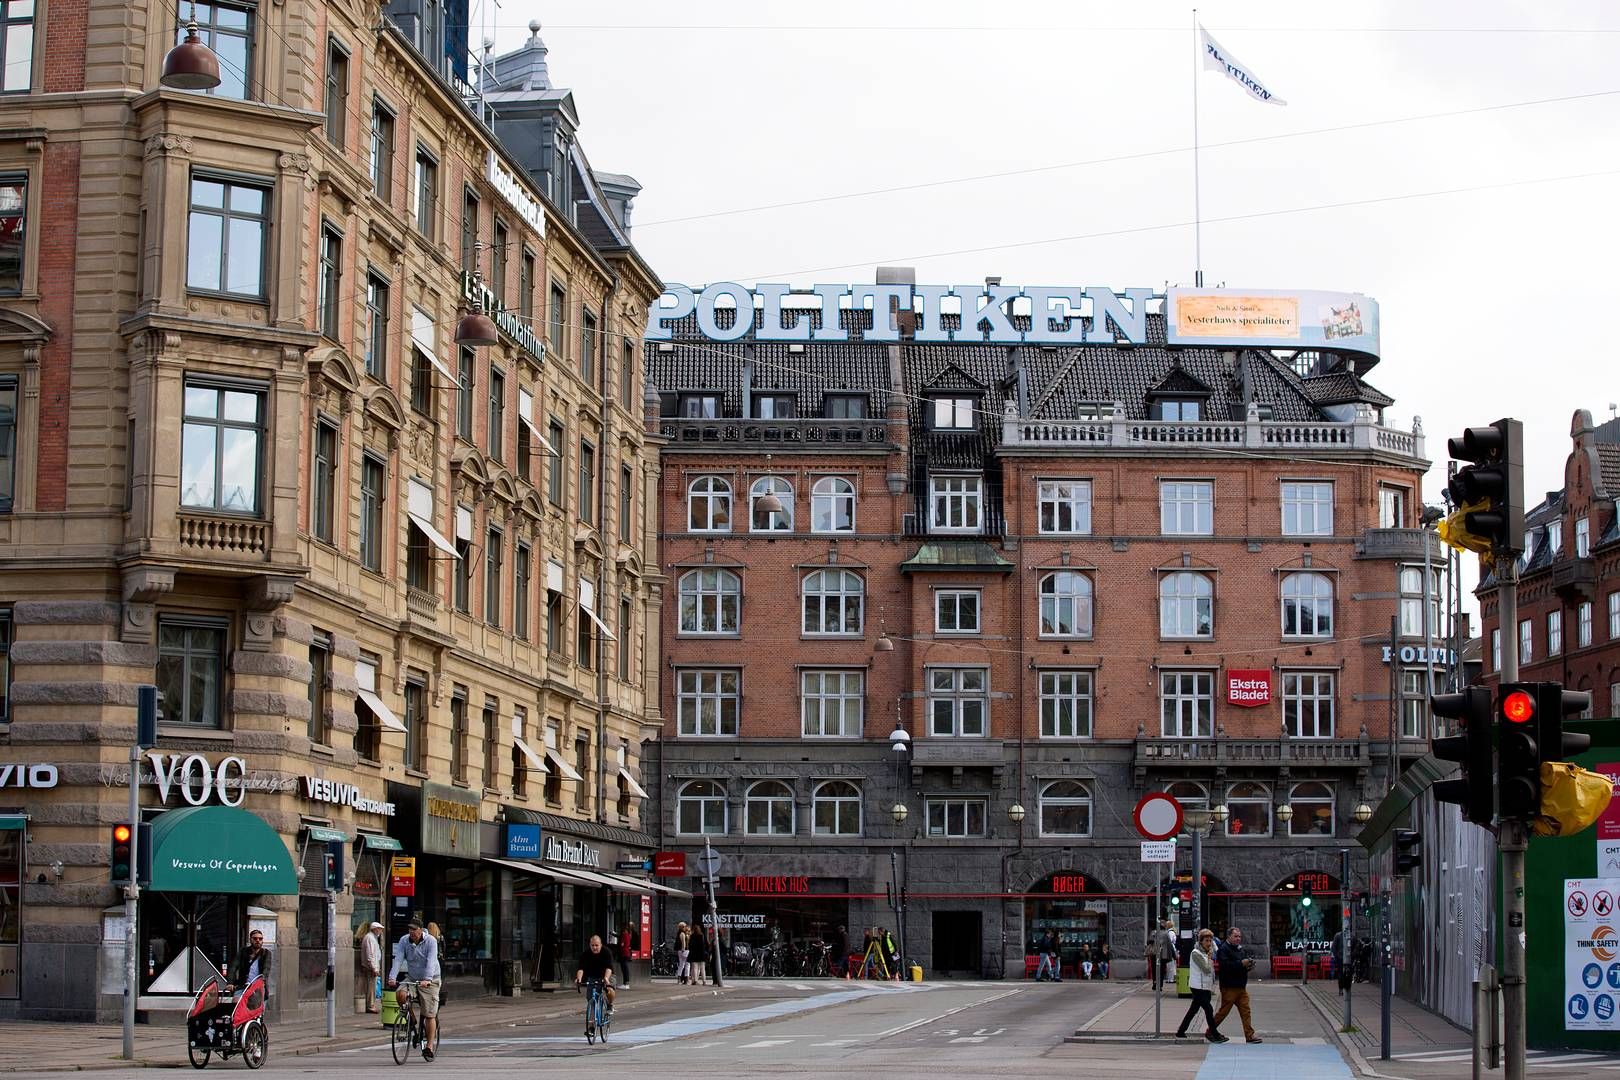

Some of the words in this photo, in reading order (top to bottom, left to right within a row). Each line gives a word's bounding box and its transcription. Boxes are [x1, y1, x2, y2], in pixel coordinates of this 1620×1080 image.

[1206, 43, 1272, 101] POITIKEN
[644, 281, 1154, 344] POLITIKEN
[1238, 315, 1292, 326] specialiteter
[1230, 679, 1268, 689] Ekstra
[1230, 689, 1269, 700] Bladet
[147, 753, 247, 807] VOC
[305, 774, 360, 808] VESUVIO
[356, 797, 396, 817] RISTORANTE
[510, 835, 529, 844] Alm
[510, 844, 537, 852] Brand
[546, 836, 562, 861] Alm
[562, 840, 583, 865] Brand
[172, 858, 206, 869] Vesuvio
[209, 859, 223, 869] Of
[225, 859, 278, 873] Copenhagen
[735, 875, 787, 893] POLITIKENS
[790, 875, 809, 893] HUS
[1053, 876, 1085, 893] BØGER
[1285, 941, 1333, 950] PLATYP
[1577, 940, 1595, 948] THINK
[1596, 939, 1619, 948] SAFETY
